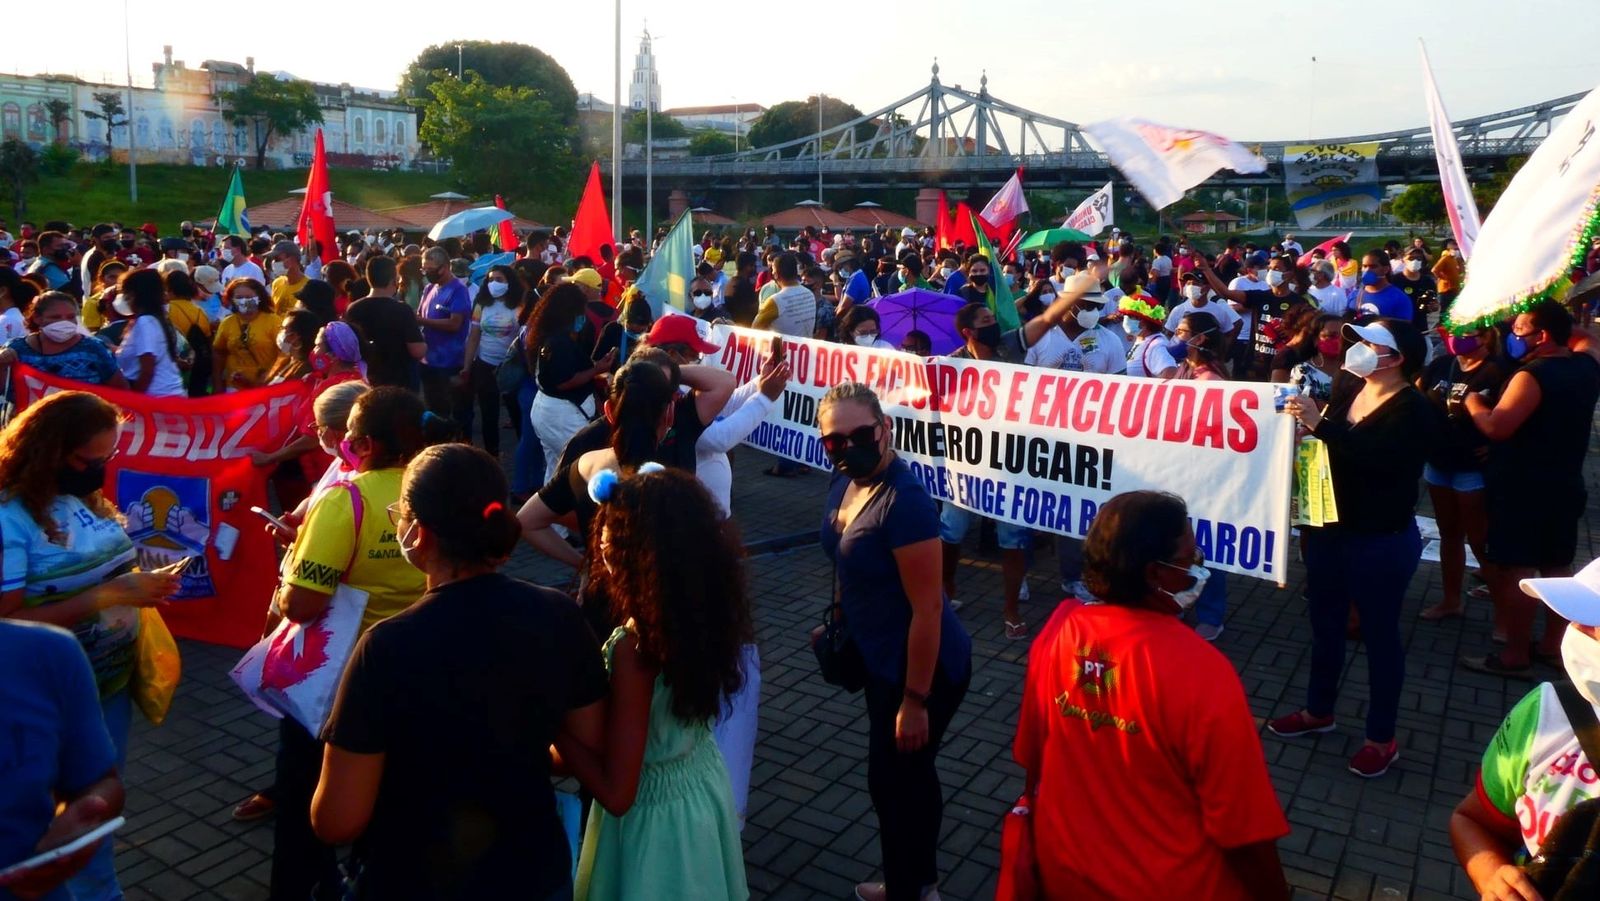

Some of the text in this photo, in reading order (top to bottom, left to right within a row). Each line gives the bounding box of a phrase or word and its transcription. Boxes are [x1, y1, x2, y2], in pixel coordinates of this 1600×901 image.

[815, 346, 858, 388] DOS
[865, 355, 1001, 422] EXCLUÍDOS
[1004, 371, 1029, 423] E
[1029, 374, 1259, 454] EXCLUÍDAS
[990, 430, 1114, 490] LUGAR!
[74, 508, 94, 528] 15
[956, 473, 1007, 516] EXIGE
[1011, 486, 1072, 533] FORA
[1084, 660, 1104, 678] PT
